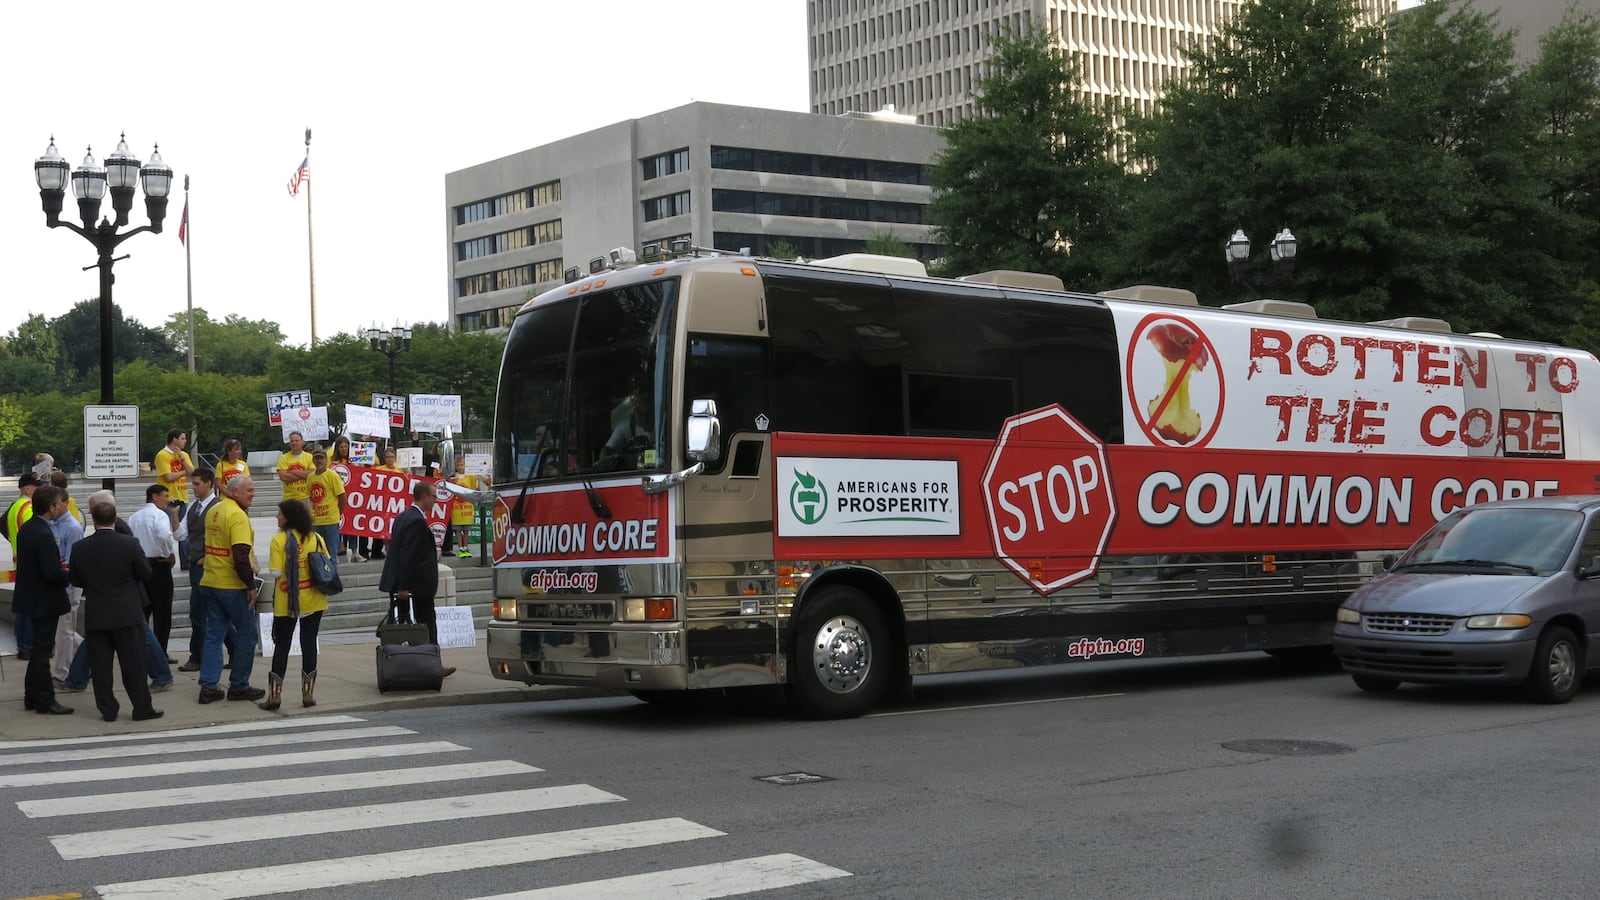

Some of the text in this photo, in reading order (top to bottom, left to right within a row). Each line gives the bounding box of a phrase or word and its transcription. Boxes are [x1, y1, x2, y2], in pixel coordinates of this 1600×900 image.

[1247, 327, 1580, 394] ROTTEN TO
[271, 395, 310, 408] PAGE
[375, 397, 404, 411] PAGE
[1266, 395, 1561, 453] THE CORE
[837, 480, 949, 494] AMERICANS FOR
[997, 454, 1099, 542] STOP
[1137, 471, 1415, 526] COMMON
[347, 492, 447, 520] OMMN
[837, 497, 950, 513] PROSPERITY
[353, 514, 395, 534] CO
[492, 513, 508, 542] TOP
[505, 518, 659, 555] COMMON CORE
[530, 569, 600, 593] afptn.org
[1067, 636, 1145, 661] afptn.org
